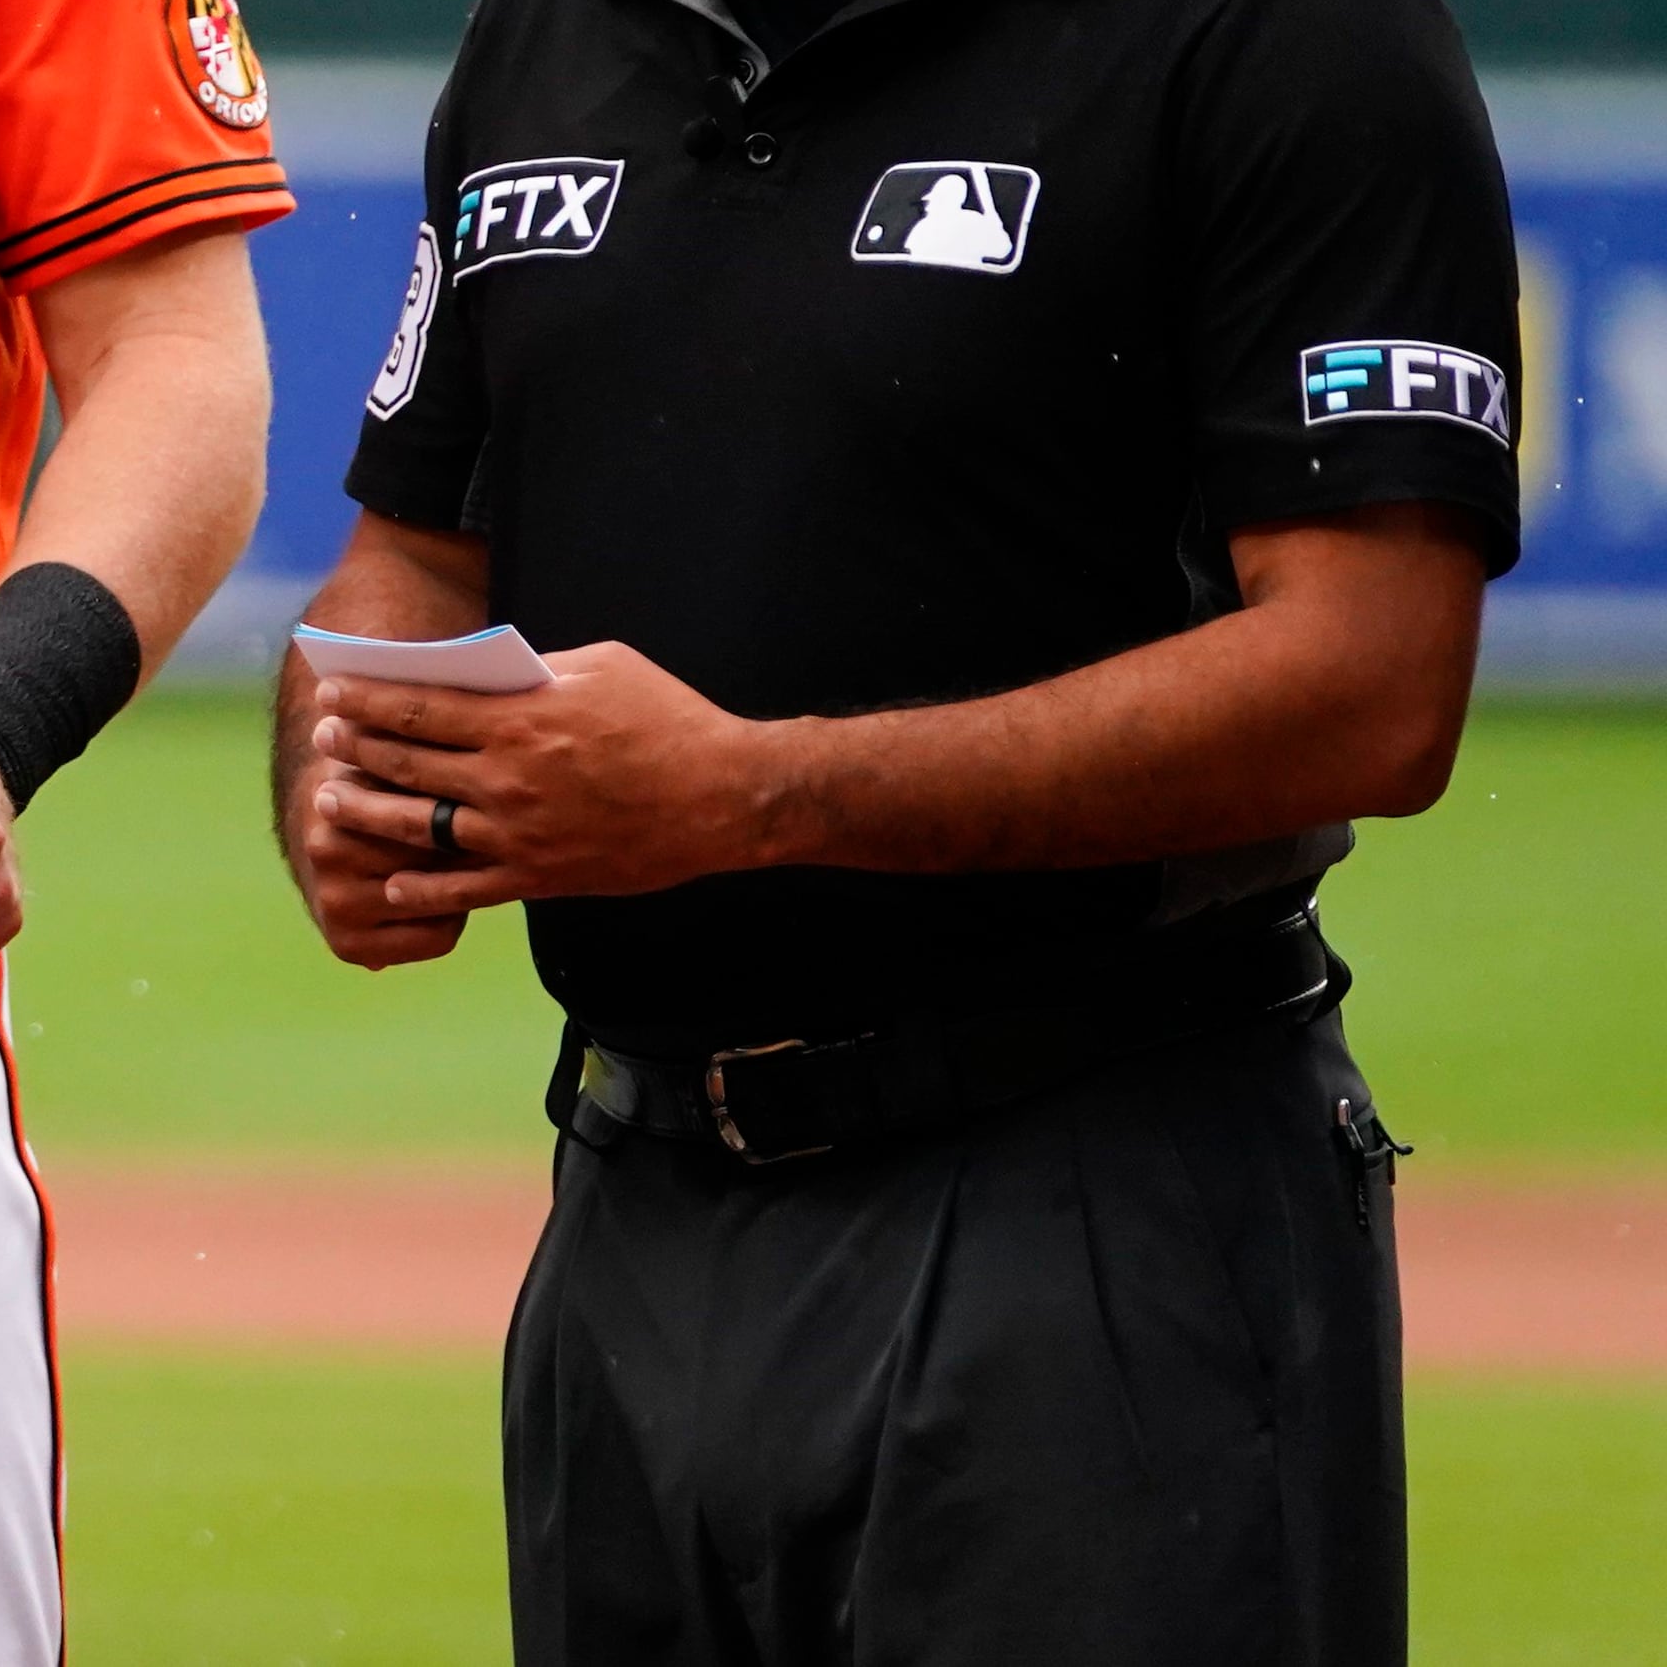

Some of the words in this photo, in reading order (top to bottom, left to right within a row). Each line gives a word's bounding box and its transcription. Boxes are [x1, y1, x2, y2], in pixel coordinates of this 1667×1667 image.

[198, 75, 268, 123] ORIOL
[475, 174, 610, 251] FTX
[1390, 347, 1510, 439] FTX
